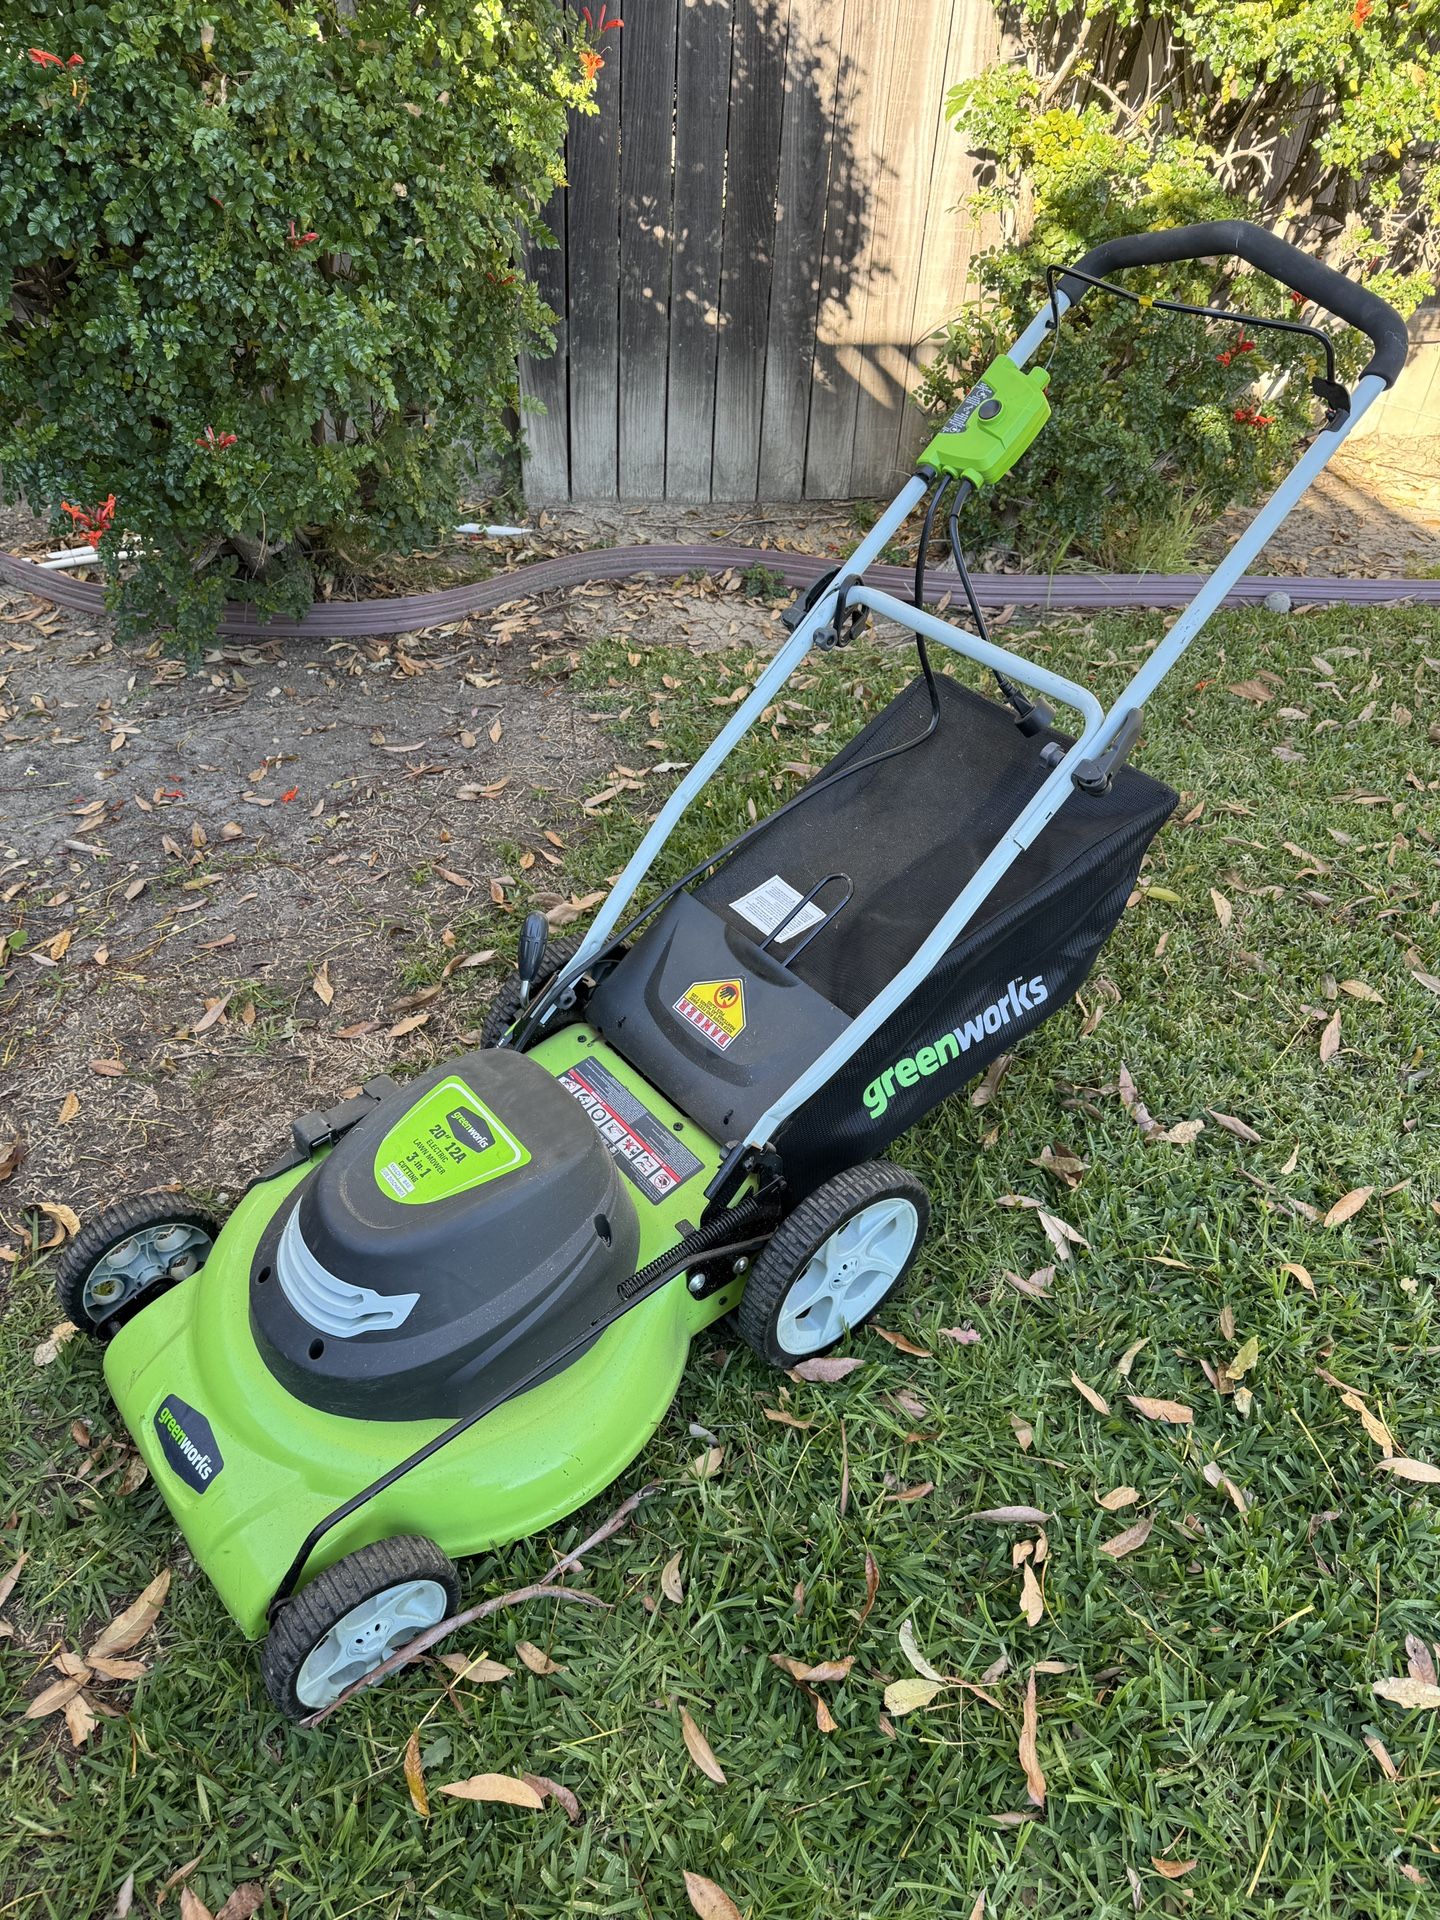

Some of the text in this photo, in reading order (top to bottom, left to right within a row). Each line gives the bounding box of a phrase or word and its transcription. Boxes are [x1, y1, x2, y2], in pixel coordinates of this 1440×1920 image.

[677, 999, 729, 1045] DANGER
[863, 975, 1048, 1119] greenworks
[451, 1112, 488, 1148] greenworks
[413, 1138, 446, 1175] LAWN MOWER
[427, 1139, 448, 1163] ELECTRIC
[445, 1142, 467, 1164] 12A
[398, 1160, 419, 1183] CUTTING
[158, 1407, 213, 1480] greenworks
